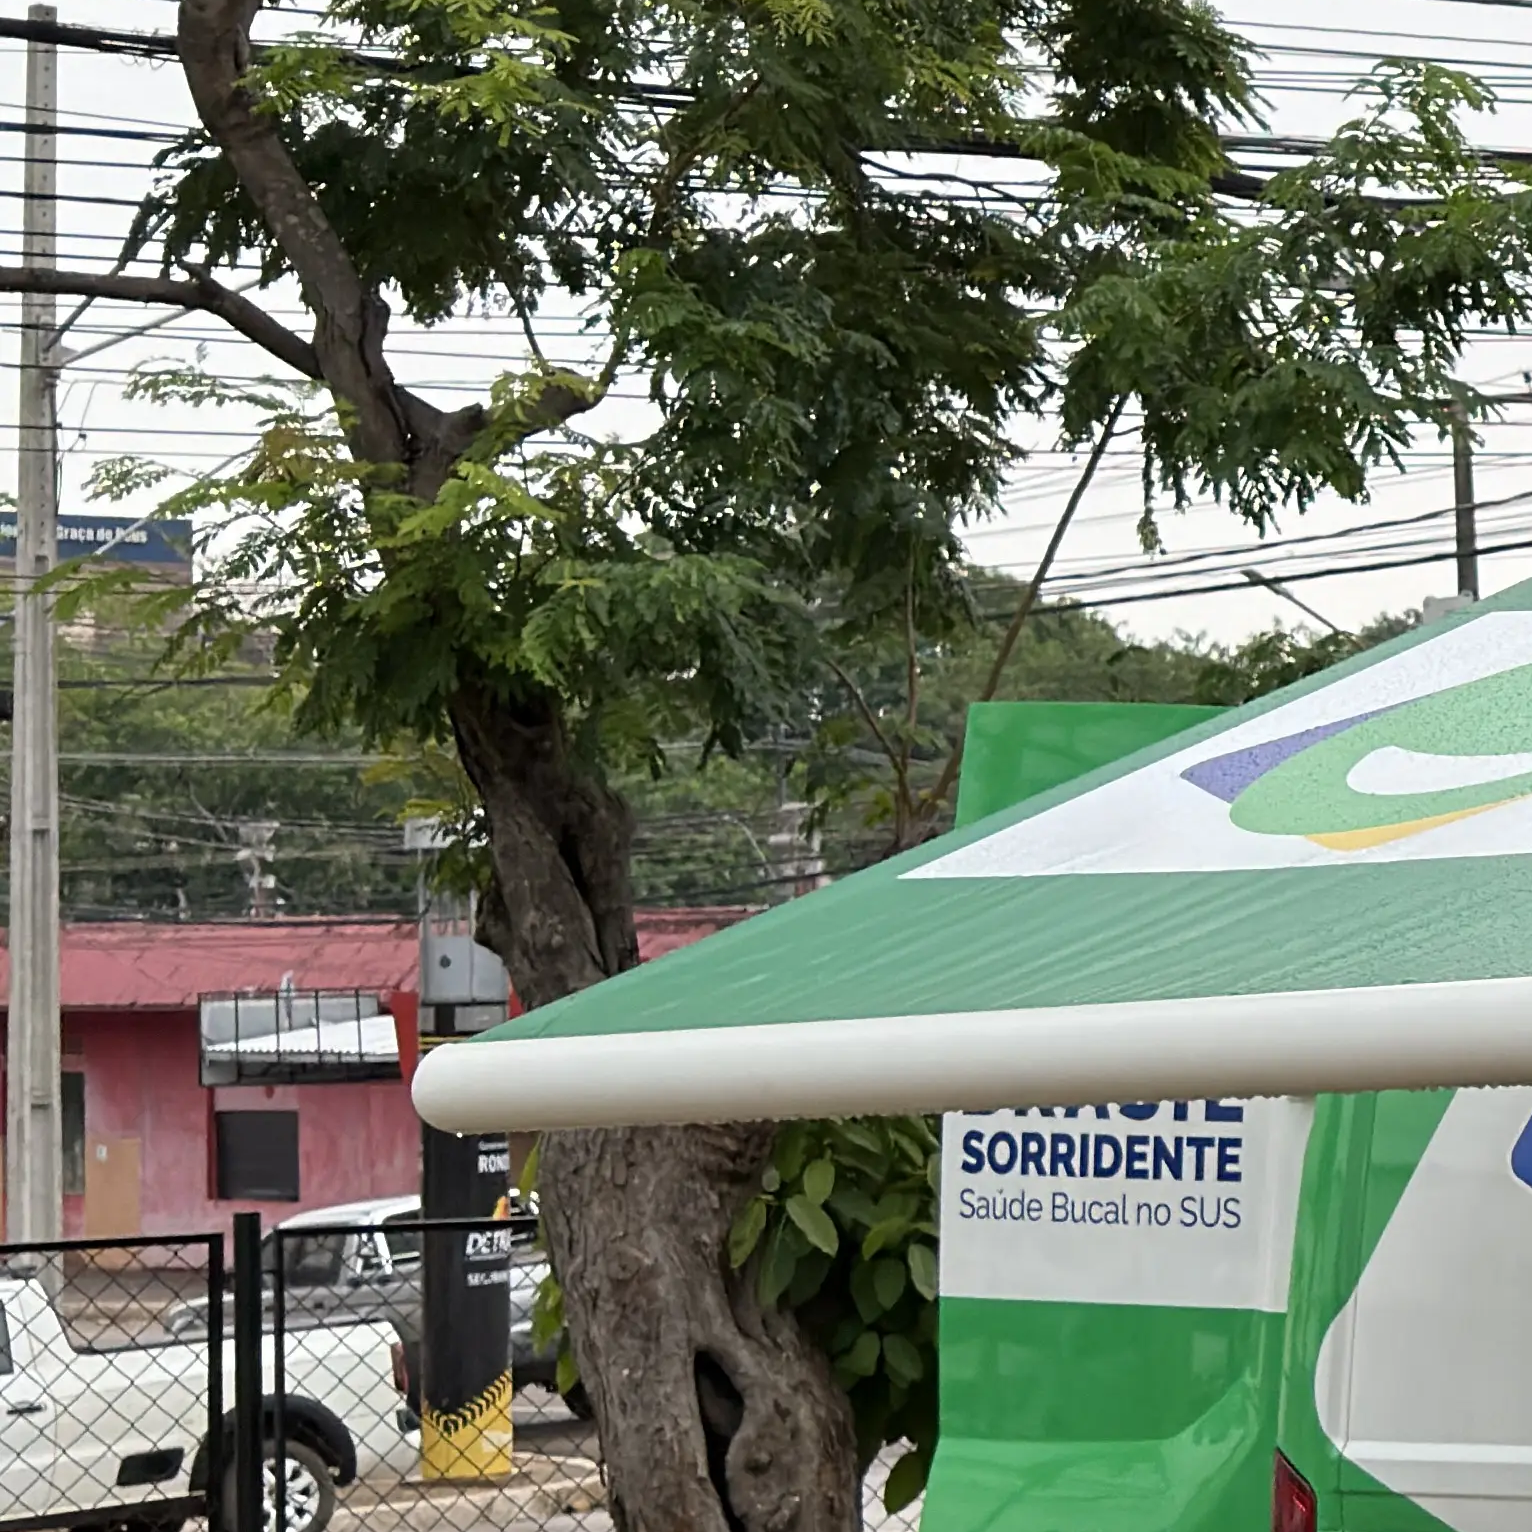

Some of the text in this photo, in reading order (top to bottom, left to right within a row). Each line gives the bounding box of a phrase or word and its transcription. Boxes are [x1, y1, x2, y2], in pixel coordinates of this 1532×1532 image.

[961, 1130, 1242, 1182] SORRIDENTE
[959, 1188, 1241, 1229] Saúde Bucal no SUS
